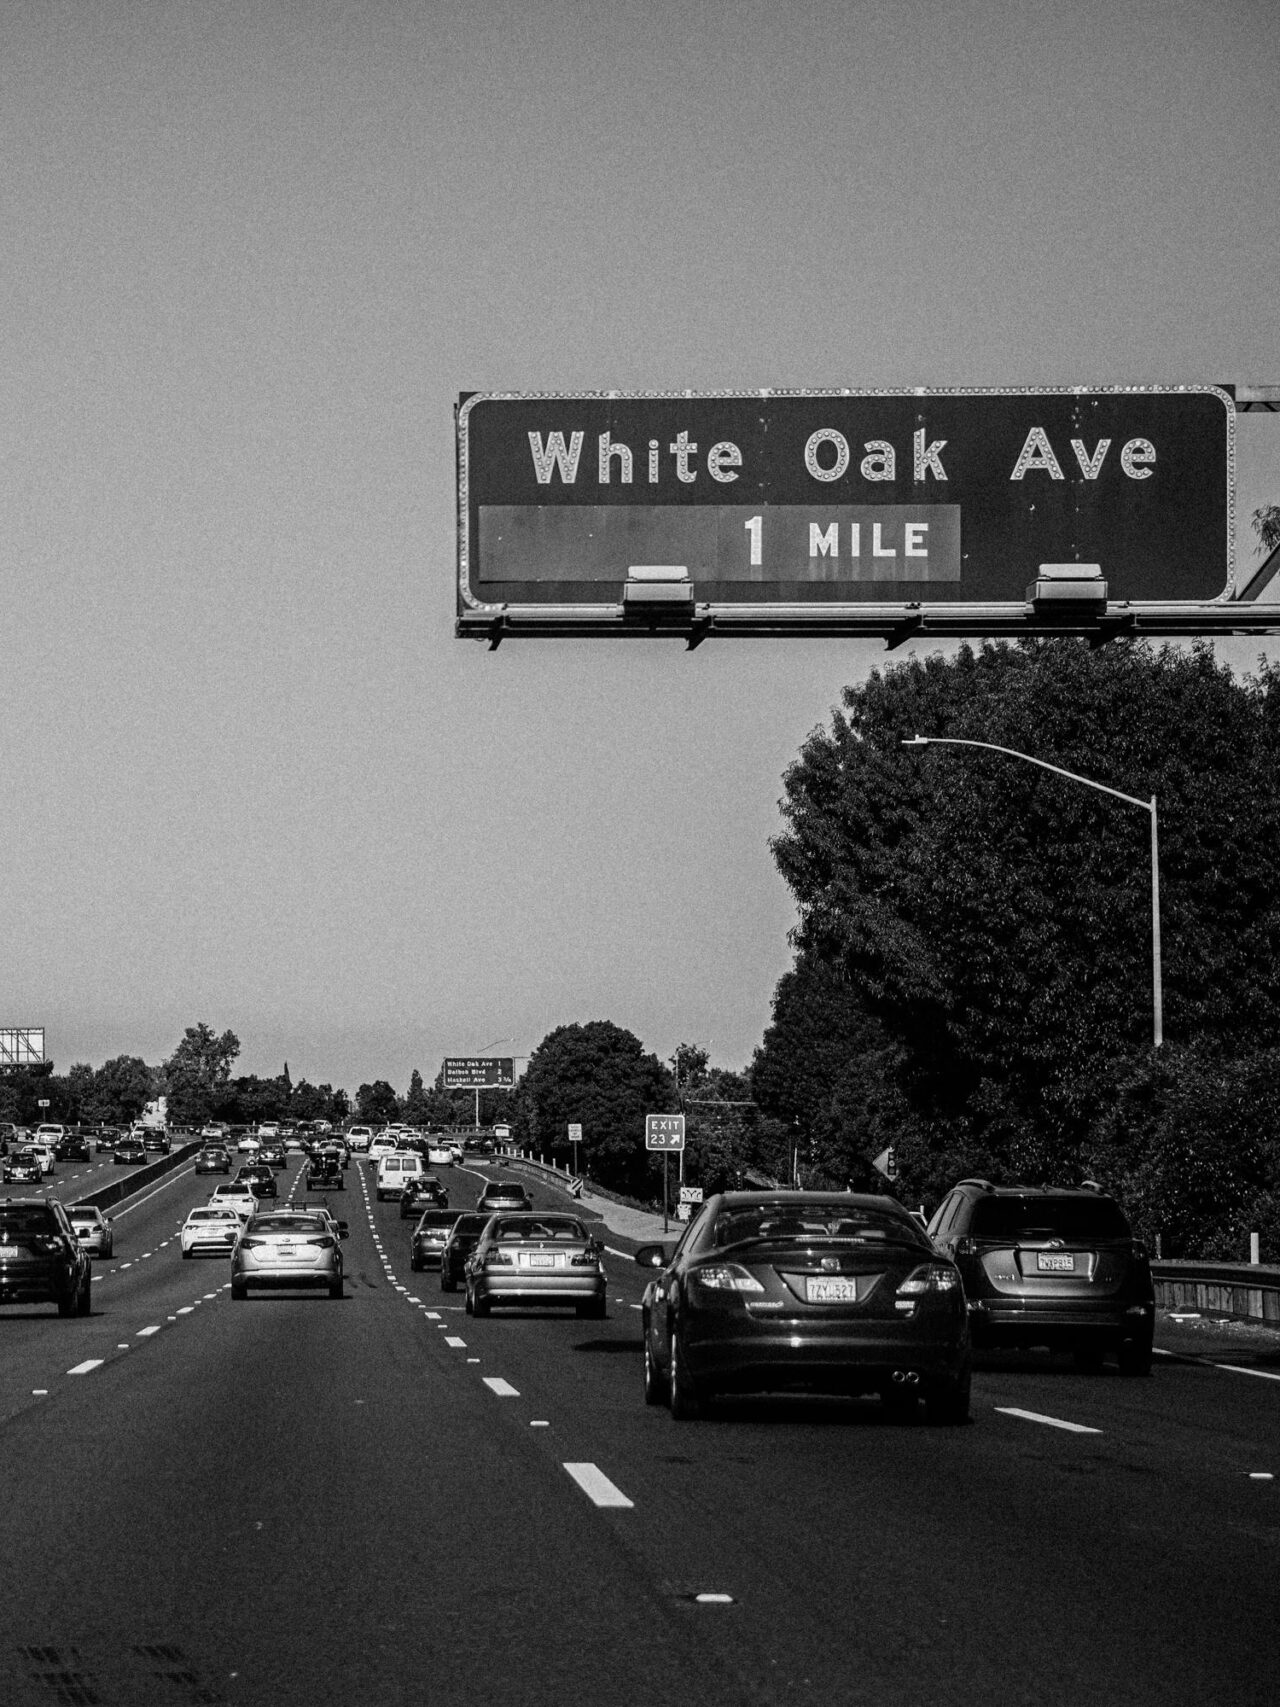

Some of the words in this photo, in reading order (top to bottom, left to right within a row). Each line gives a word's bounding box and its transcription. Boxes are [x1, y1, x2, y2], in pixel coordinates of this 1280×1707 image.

[528, 431, 742, 483] White
[804, 428, 948, 482] Oak
[1010, 427, 1156, 480] Ave
[745, 516, 762, 565] 1
[809, 523, 928, 557] MILE
[651, 1121, 680, 1130] EXIT
[651, 1134, 666, 1144] 23
